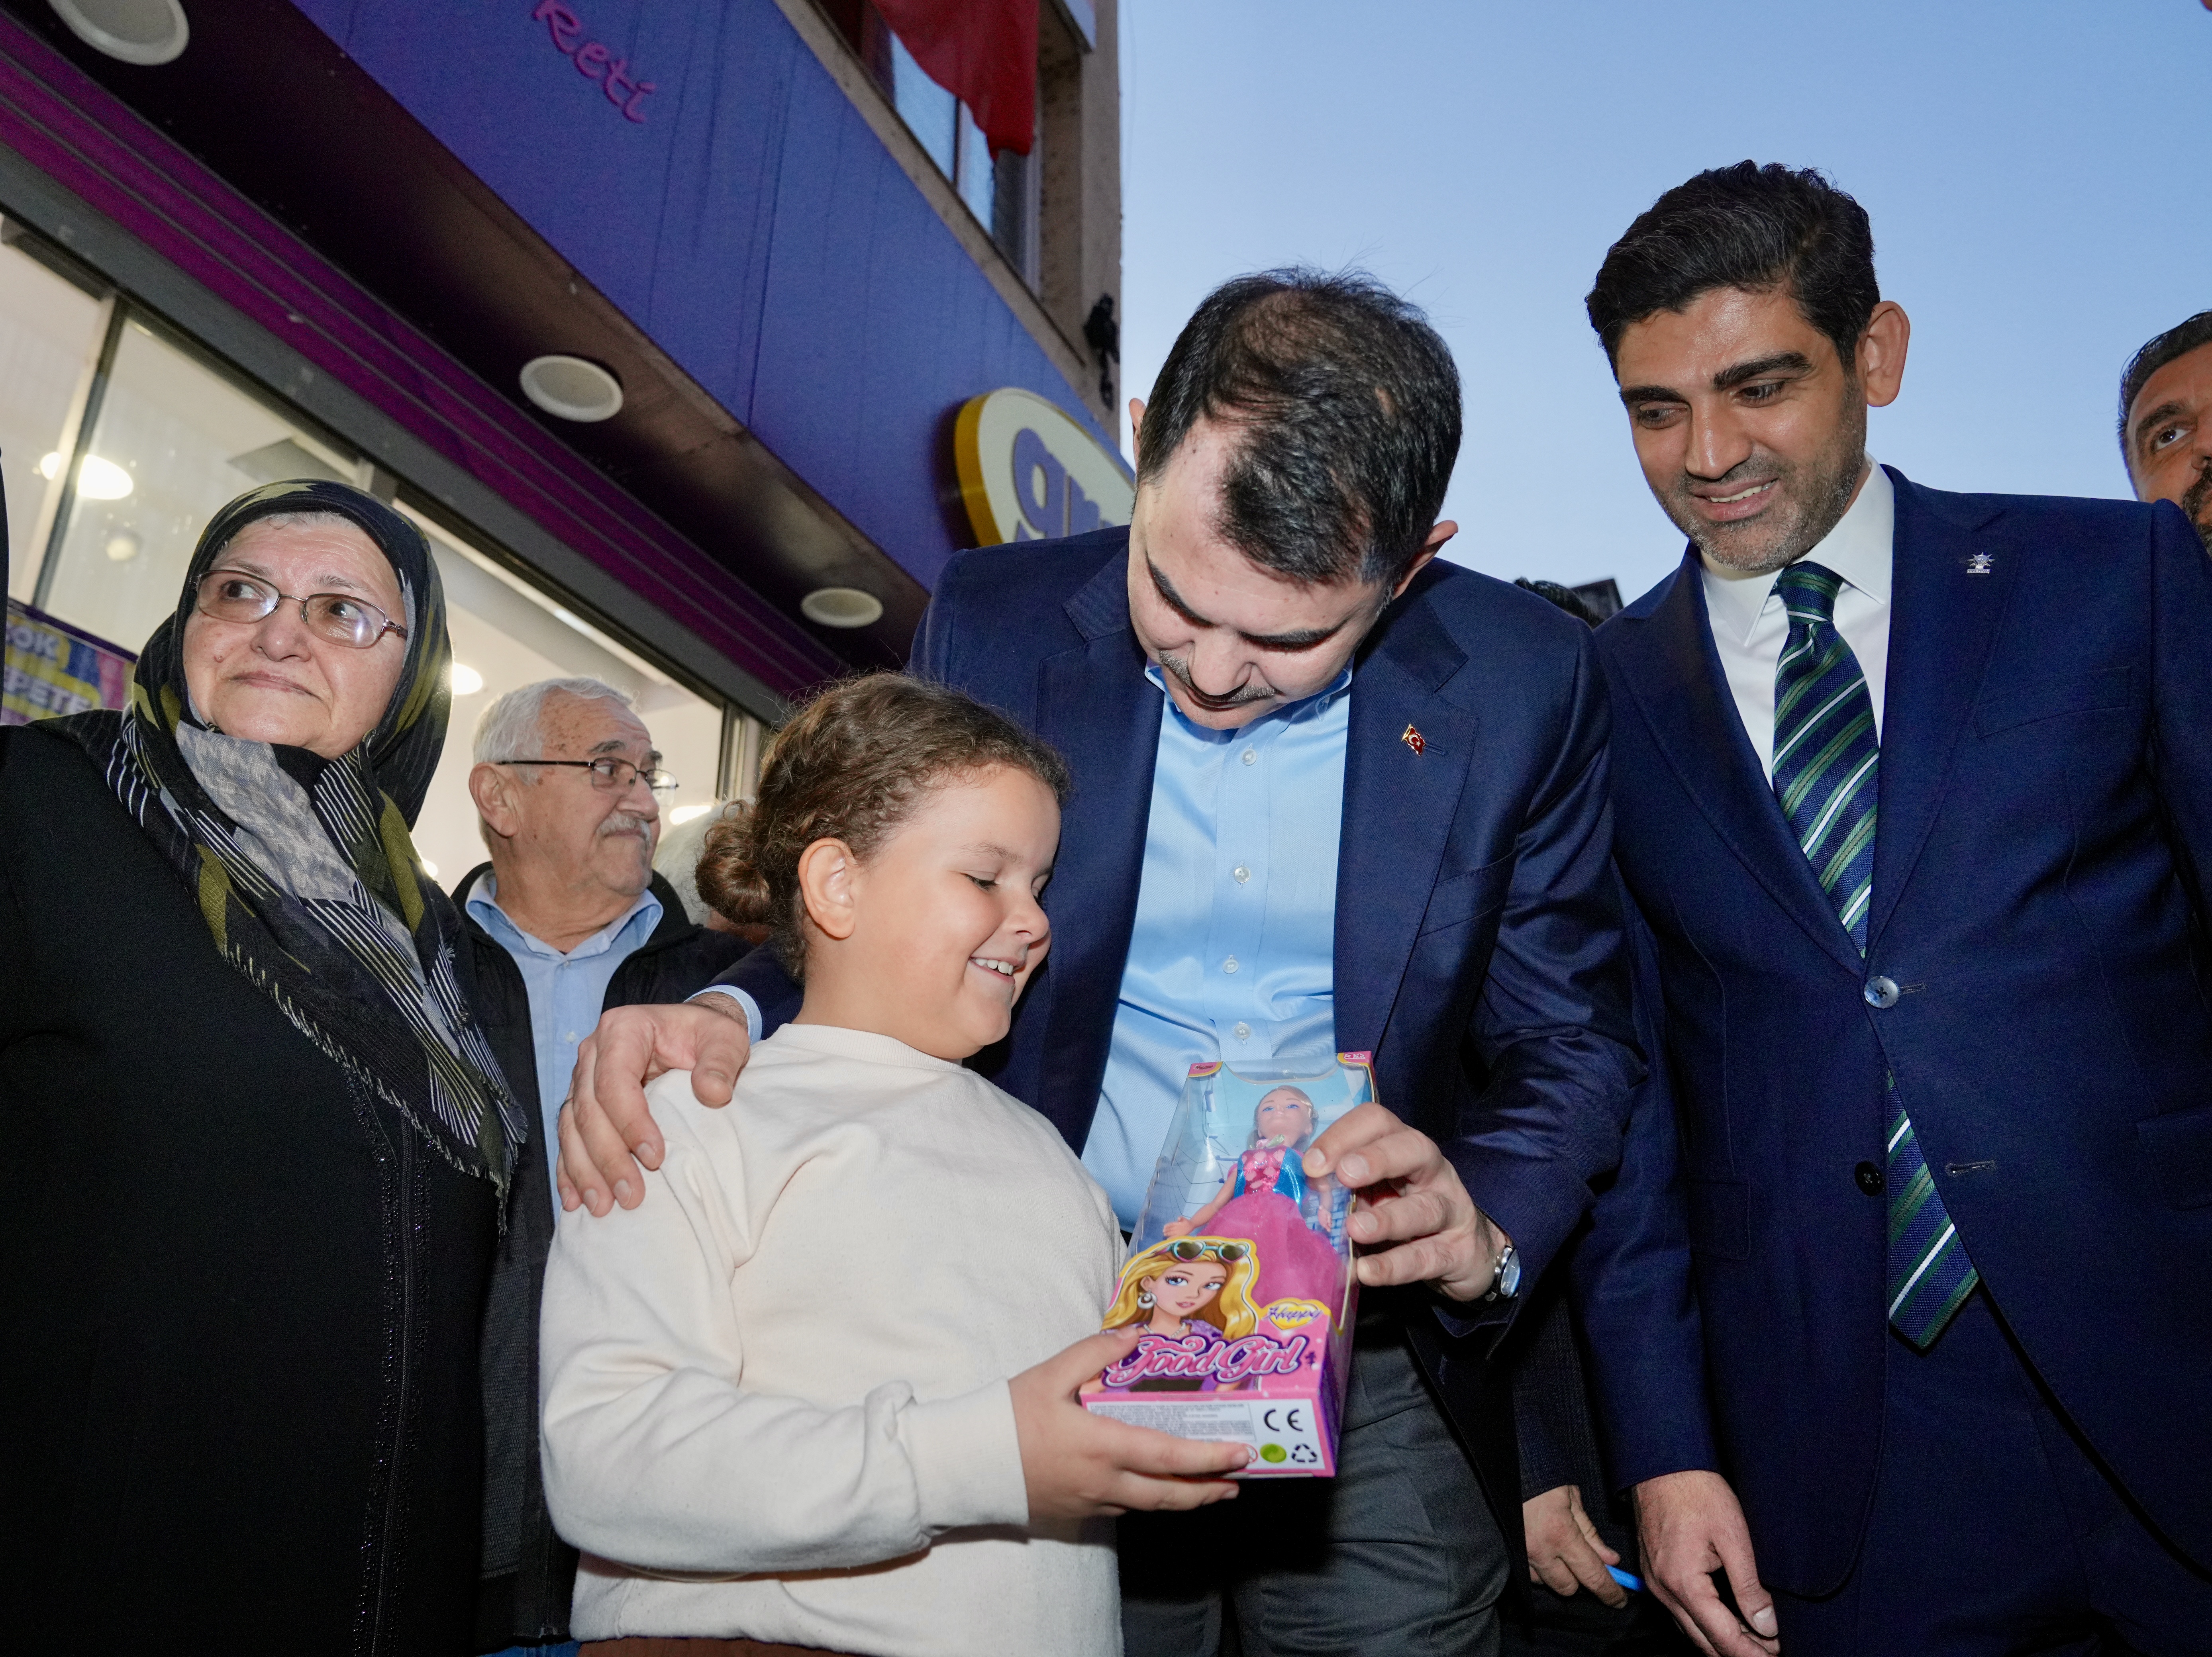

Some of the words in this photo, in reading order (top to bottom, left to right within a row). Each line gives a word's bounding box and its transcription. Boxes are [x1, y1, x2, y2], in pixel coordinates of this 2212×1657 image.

[1262, 1306, 1322, 1323] Happy
[1106, 1336, 1226, 1387] Good
[1216, 1336, 1307, 1382] Girl
[1264, 1409, 1303, 1432] CE
